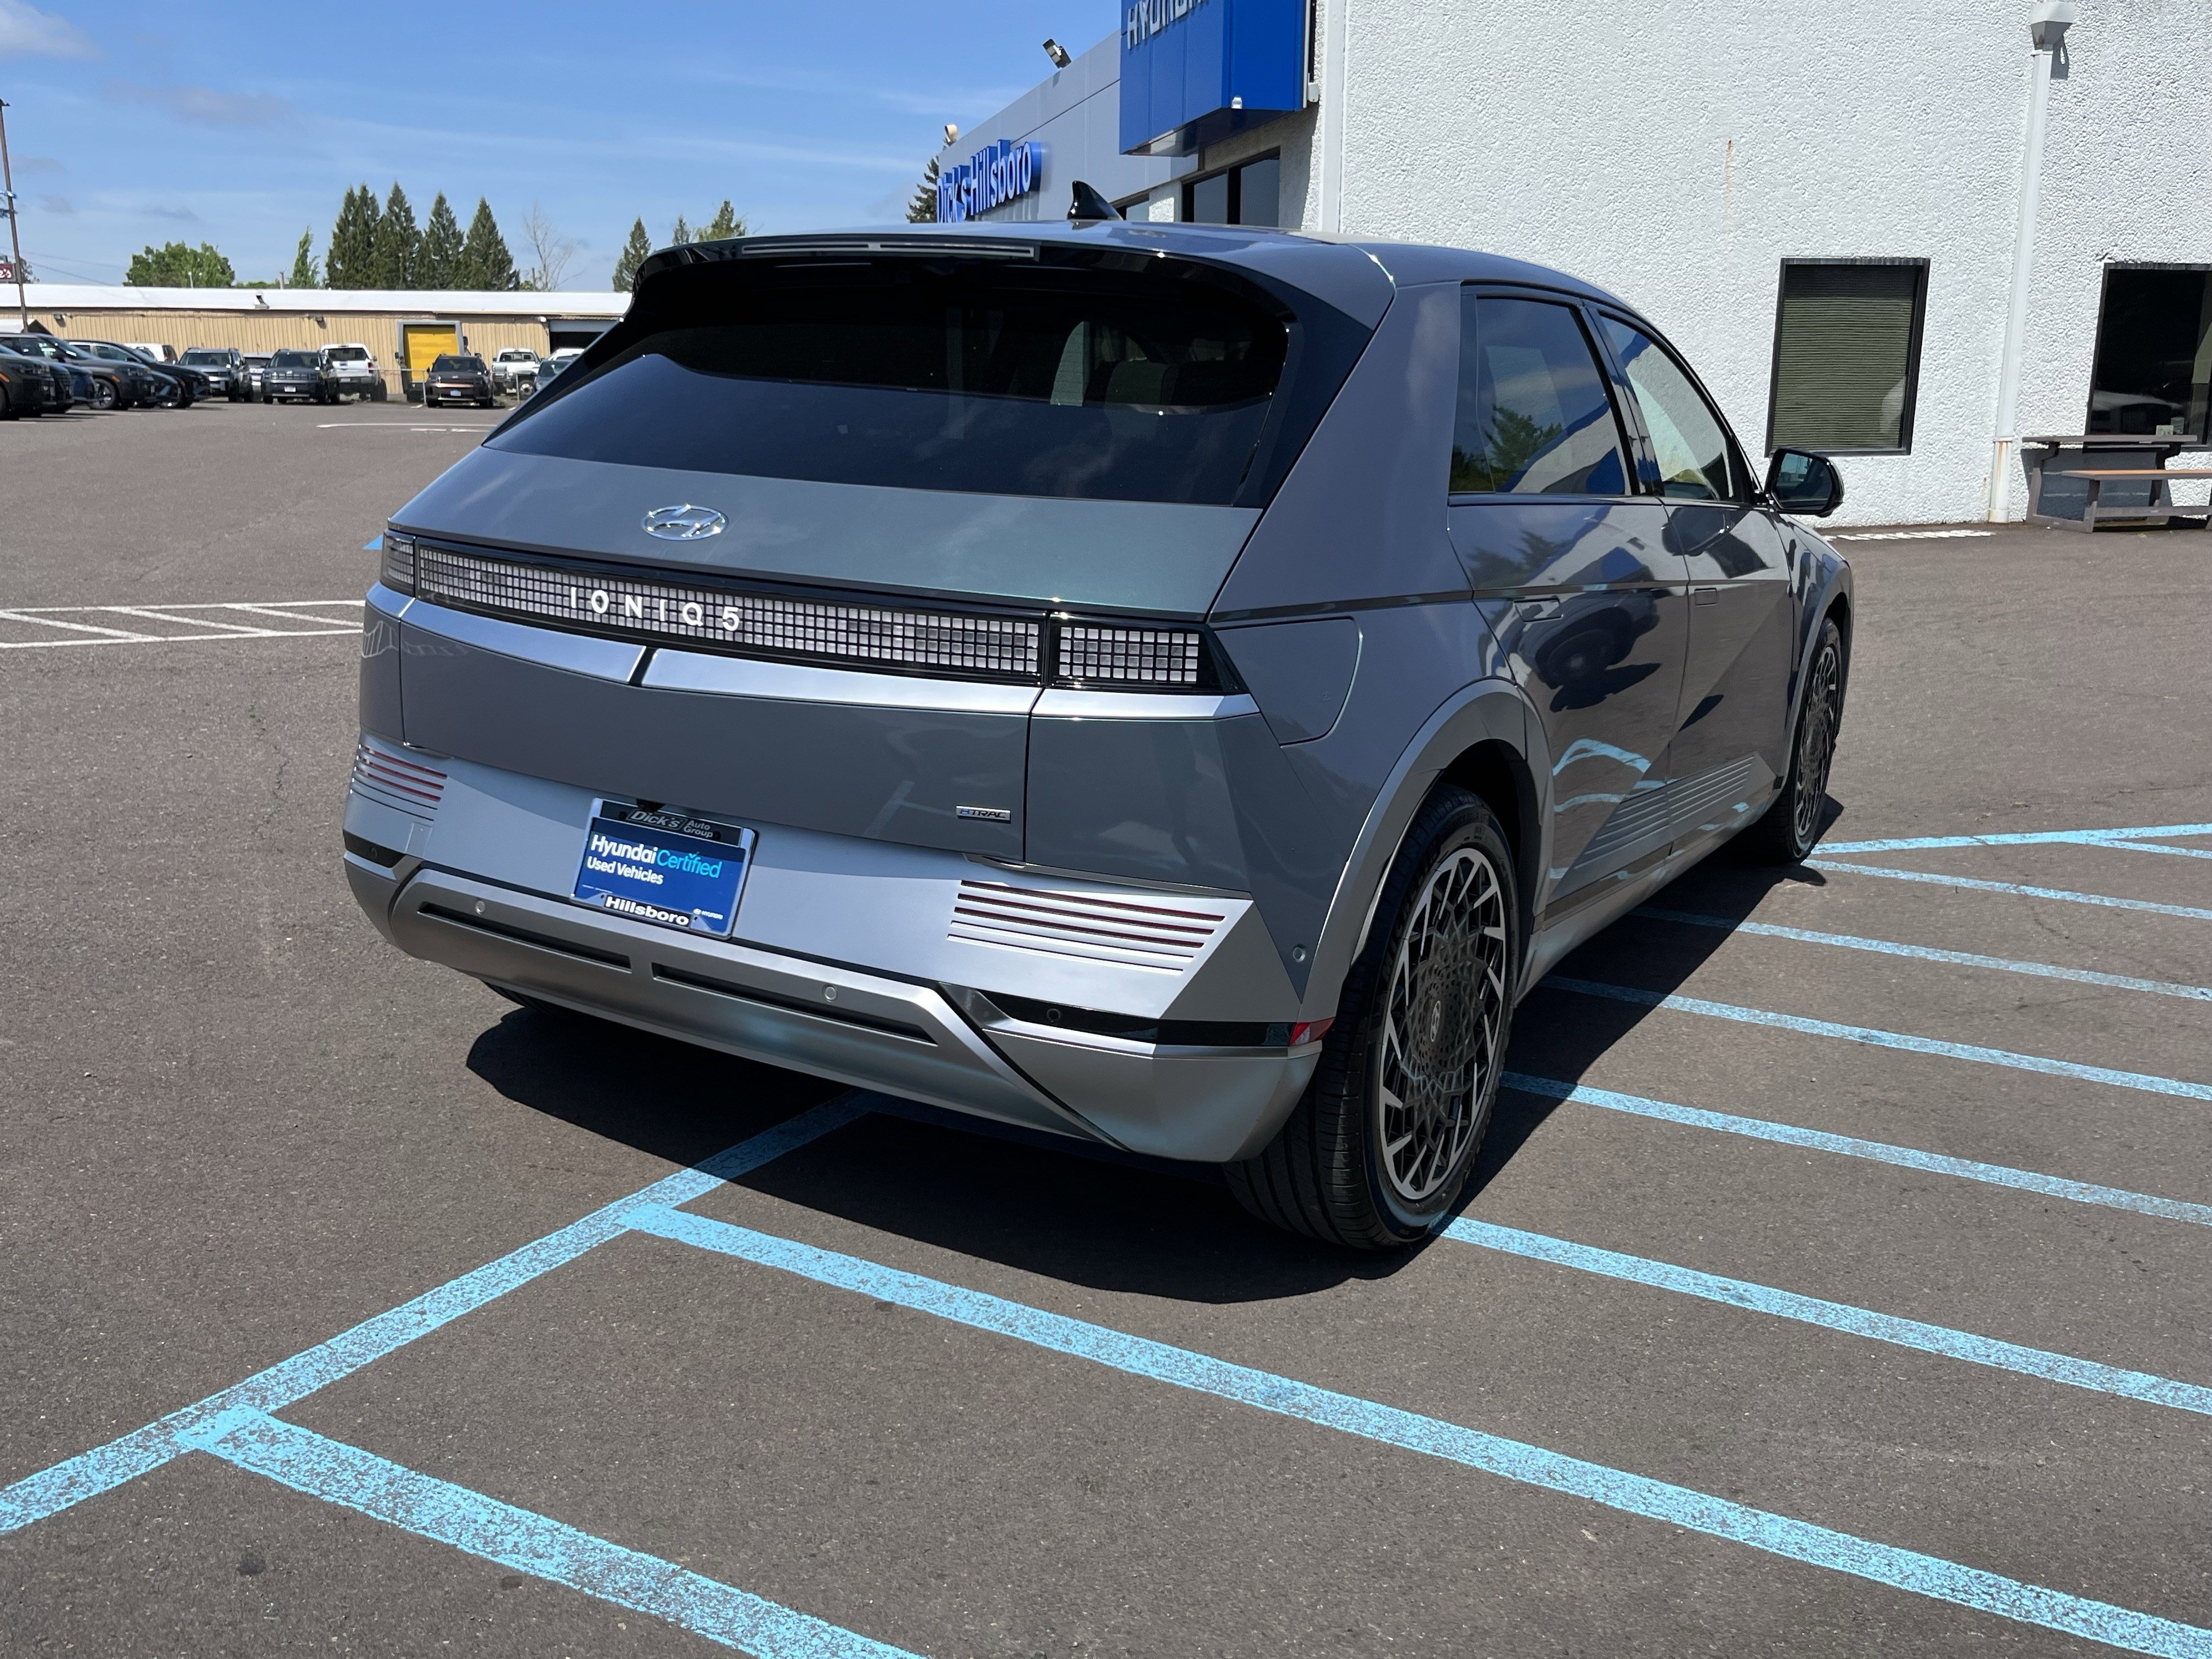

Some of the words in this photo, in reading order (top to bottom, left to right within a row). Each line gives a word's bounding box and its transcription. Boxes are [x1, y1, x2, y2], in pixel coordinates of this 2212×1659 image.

[970, 140, 1033, 216] Hillsboro
[571, 586, 703, 627] IONIQ
[722, 606, 740, 631] 5
[630, 810, 681, 828] Dick's
[683, 826, 713, 838] Group
[687, 820, 711, 831] Auto
[587, 856, 617, 873] Used
[617, 862, 664, 885] Vehicles
[590, 834, 658, 865] Hyundai
[657, 849, 723, 878] Certified
[605, 896, 689, 926] Hillsboro
